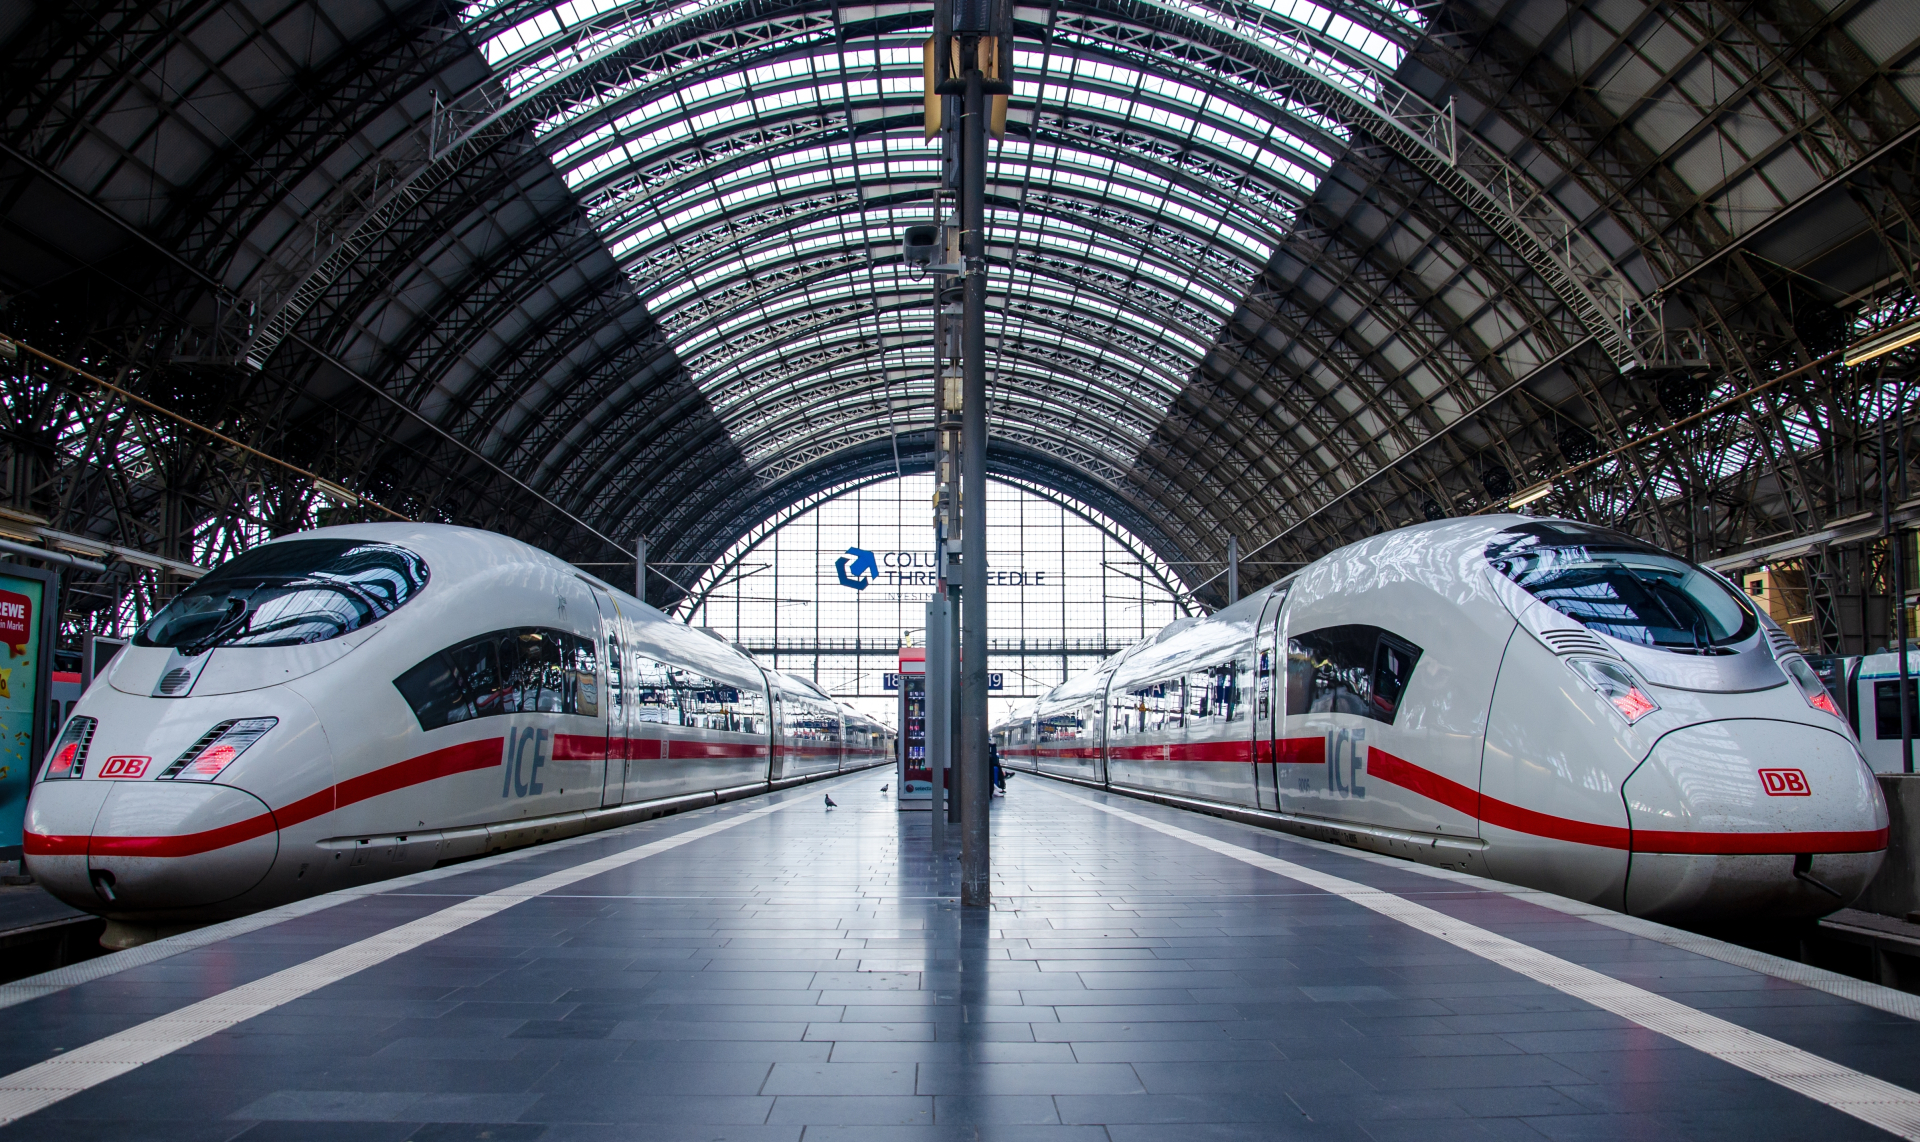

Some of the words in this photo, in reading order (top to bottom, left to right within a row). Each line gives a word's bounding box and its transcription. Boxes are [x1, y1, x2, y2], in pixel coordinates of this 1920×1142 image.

[885, 571, 1045, 585] THREEEDLE
[6, 620, 24, 632] Markt
[885, 673, 899, 687] 18
[988, 673, 1002, 687] 19
[106, 758, 142, 774] DB
[502, 726, 549, 798] ICE
[1327, 728, 1366, 799] ICE
[1765, 772, 1804, 792] DB
